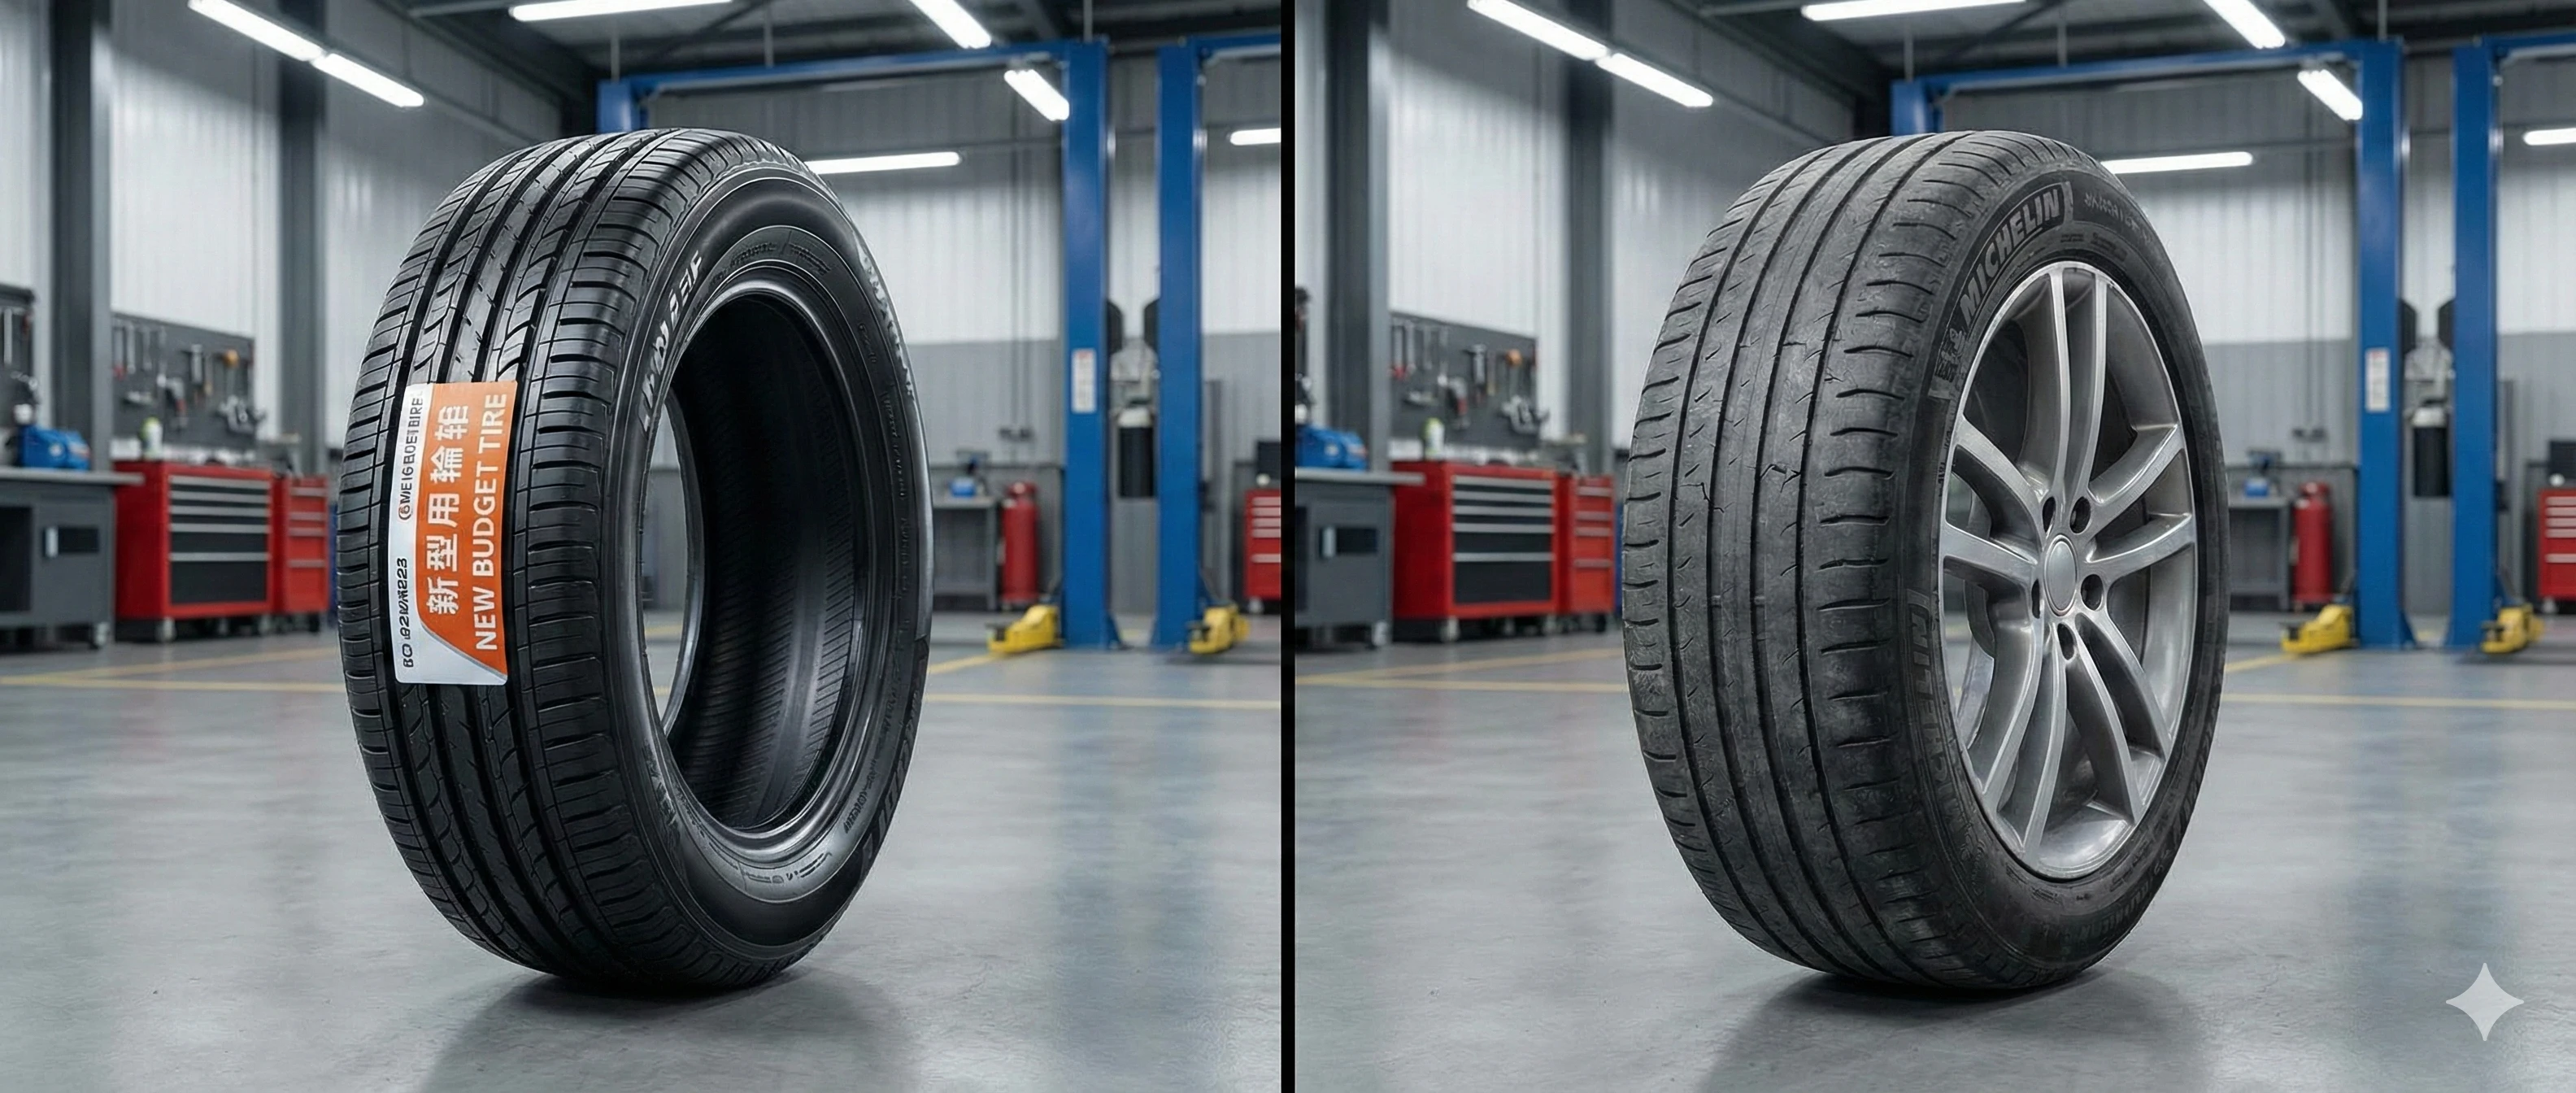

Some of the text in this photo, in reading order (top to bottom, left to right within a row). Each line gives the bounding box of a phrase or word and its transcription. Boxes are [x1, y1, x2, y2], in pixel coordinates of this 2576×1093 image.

[1960, 189, 2060, 325] MICHELIN
[472, 394, 507, 650] NEW BUDGET TIRE
